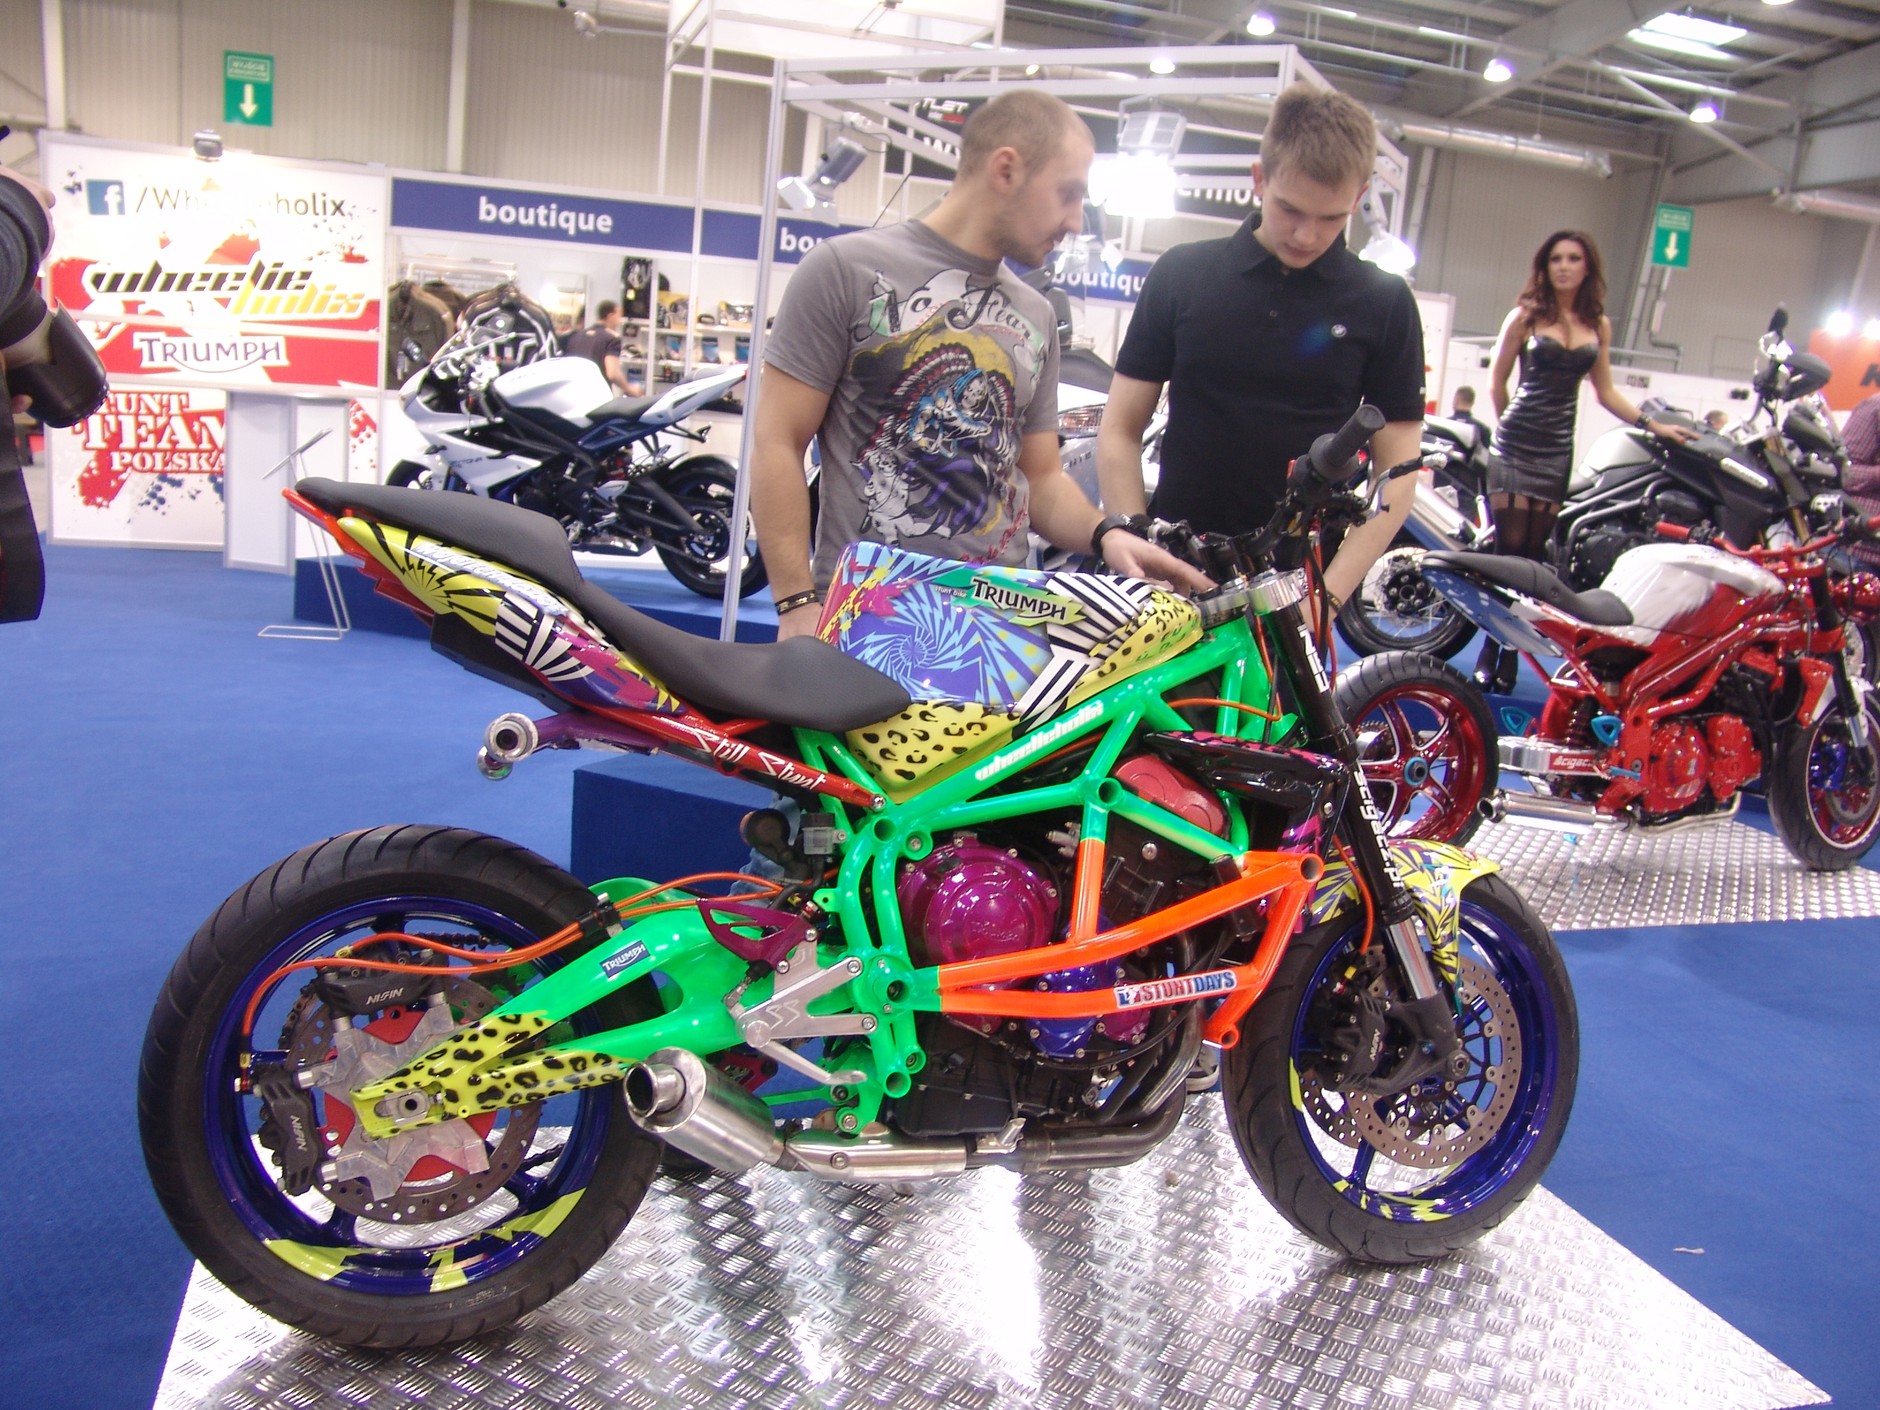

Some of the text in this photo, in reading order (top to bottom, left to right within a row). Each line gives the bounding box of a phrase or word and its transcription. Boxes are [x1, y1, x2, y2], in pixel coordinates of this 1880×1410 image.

[478, 195, 614, 236] boutique
[90, 259, 313, 293] wheelie
[138, 337, 281, 368] TRIUMPH
[973, 578, 1067, 621] TRIUMPH
[692, 726, 827, 790] Still Stunt
[602, 944, 647, 971] TRIUMPH
[1142, 970, 1236, 1002] STUNTDAYS
